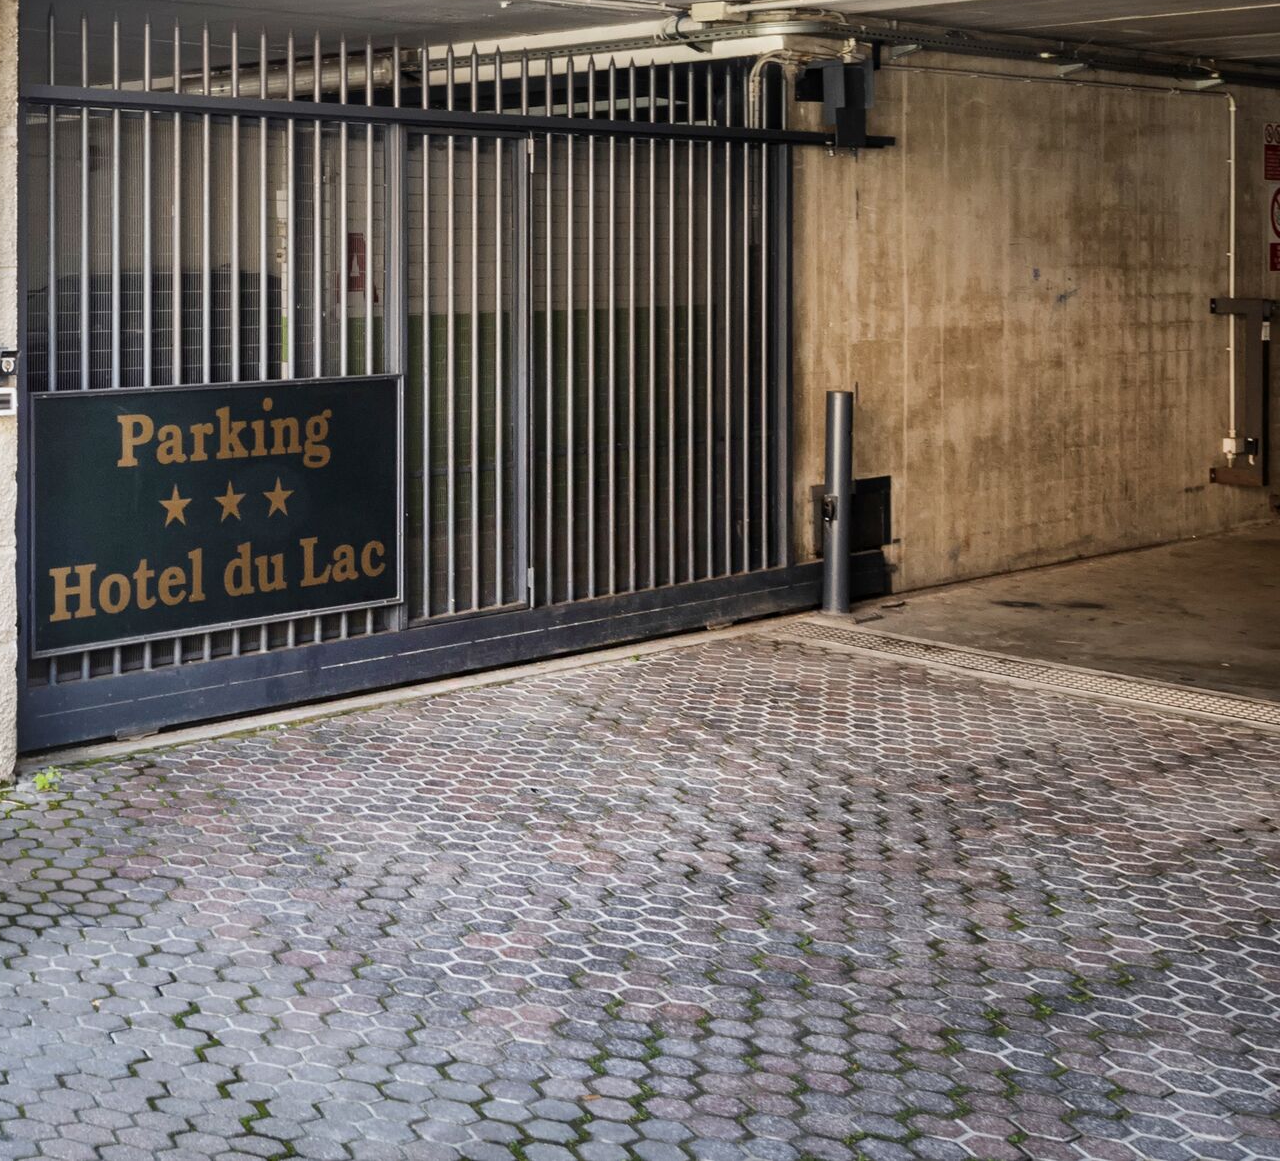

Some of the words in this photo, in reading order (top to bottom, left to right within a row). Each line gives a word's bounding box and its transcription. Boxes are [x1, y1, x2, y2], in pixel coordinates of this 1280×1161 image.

[117, 398, 332, 468] Parking
[49, 548, 206, 622] Hotel
[224, 542, 287, 597] du
[300, 536, 385, 587] Lac
